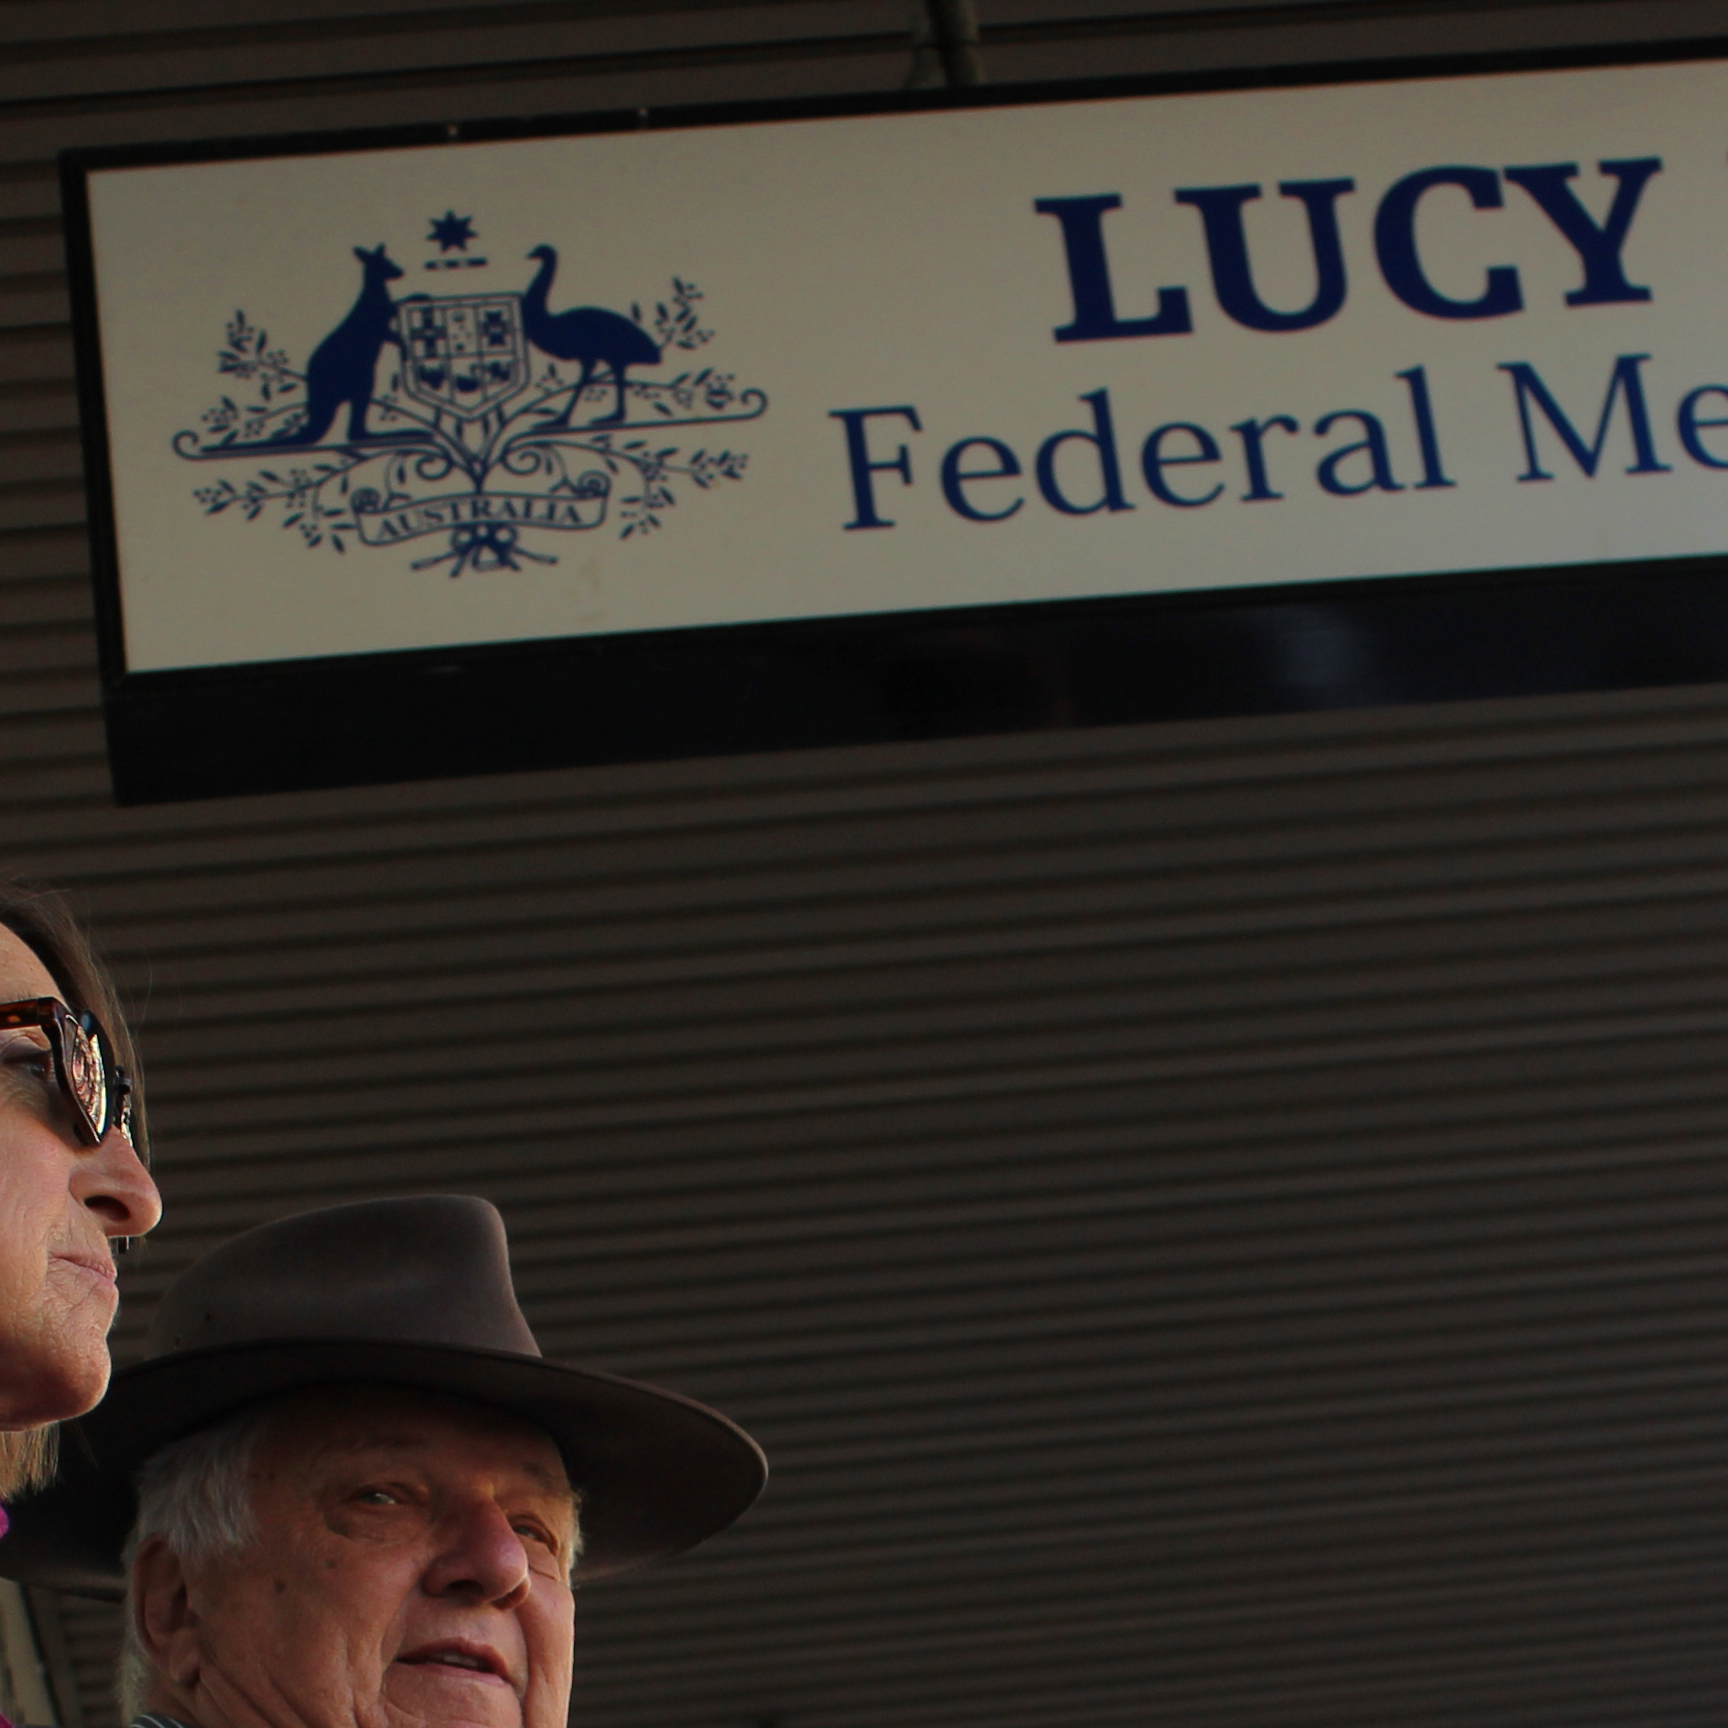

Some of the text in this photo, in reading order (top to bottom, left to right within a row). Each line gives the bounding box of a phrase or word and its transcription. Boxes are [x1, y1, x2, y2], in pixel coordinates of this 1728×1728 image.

[1032, 154, 1663, 343] LUCY
[376, 498, 582, 541] AUSTRALIA
[828, 364, 1456, 530] Federal
